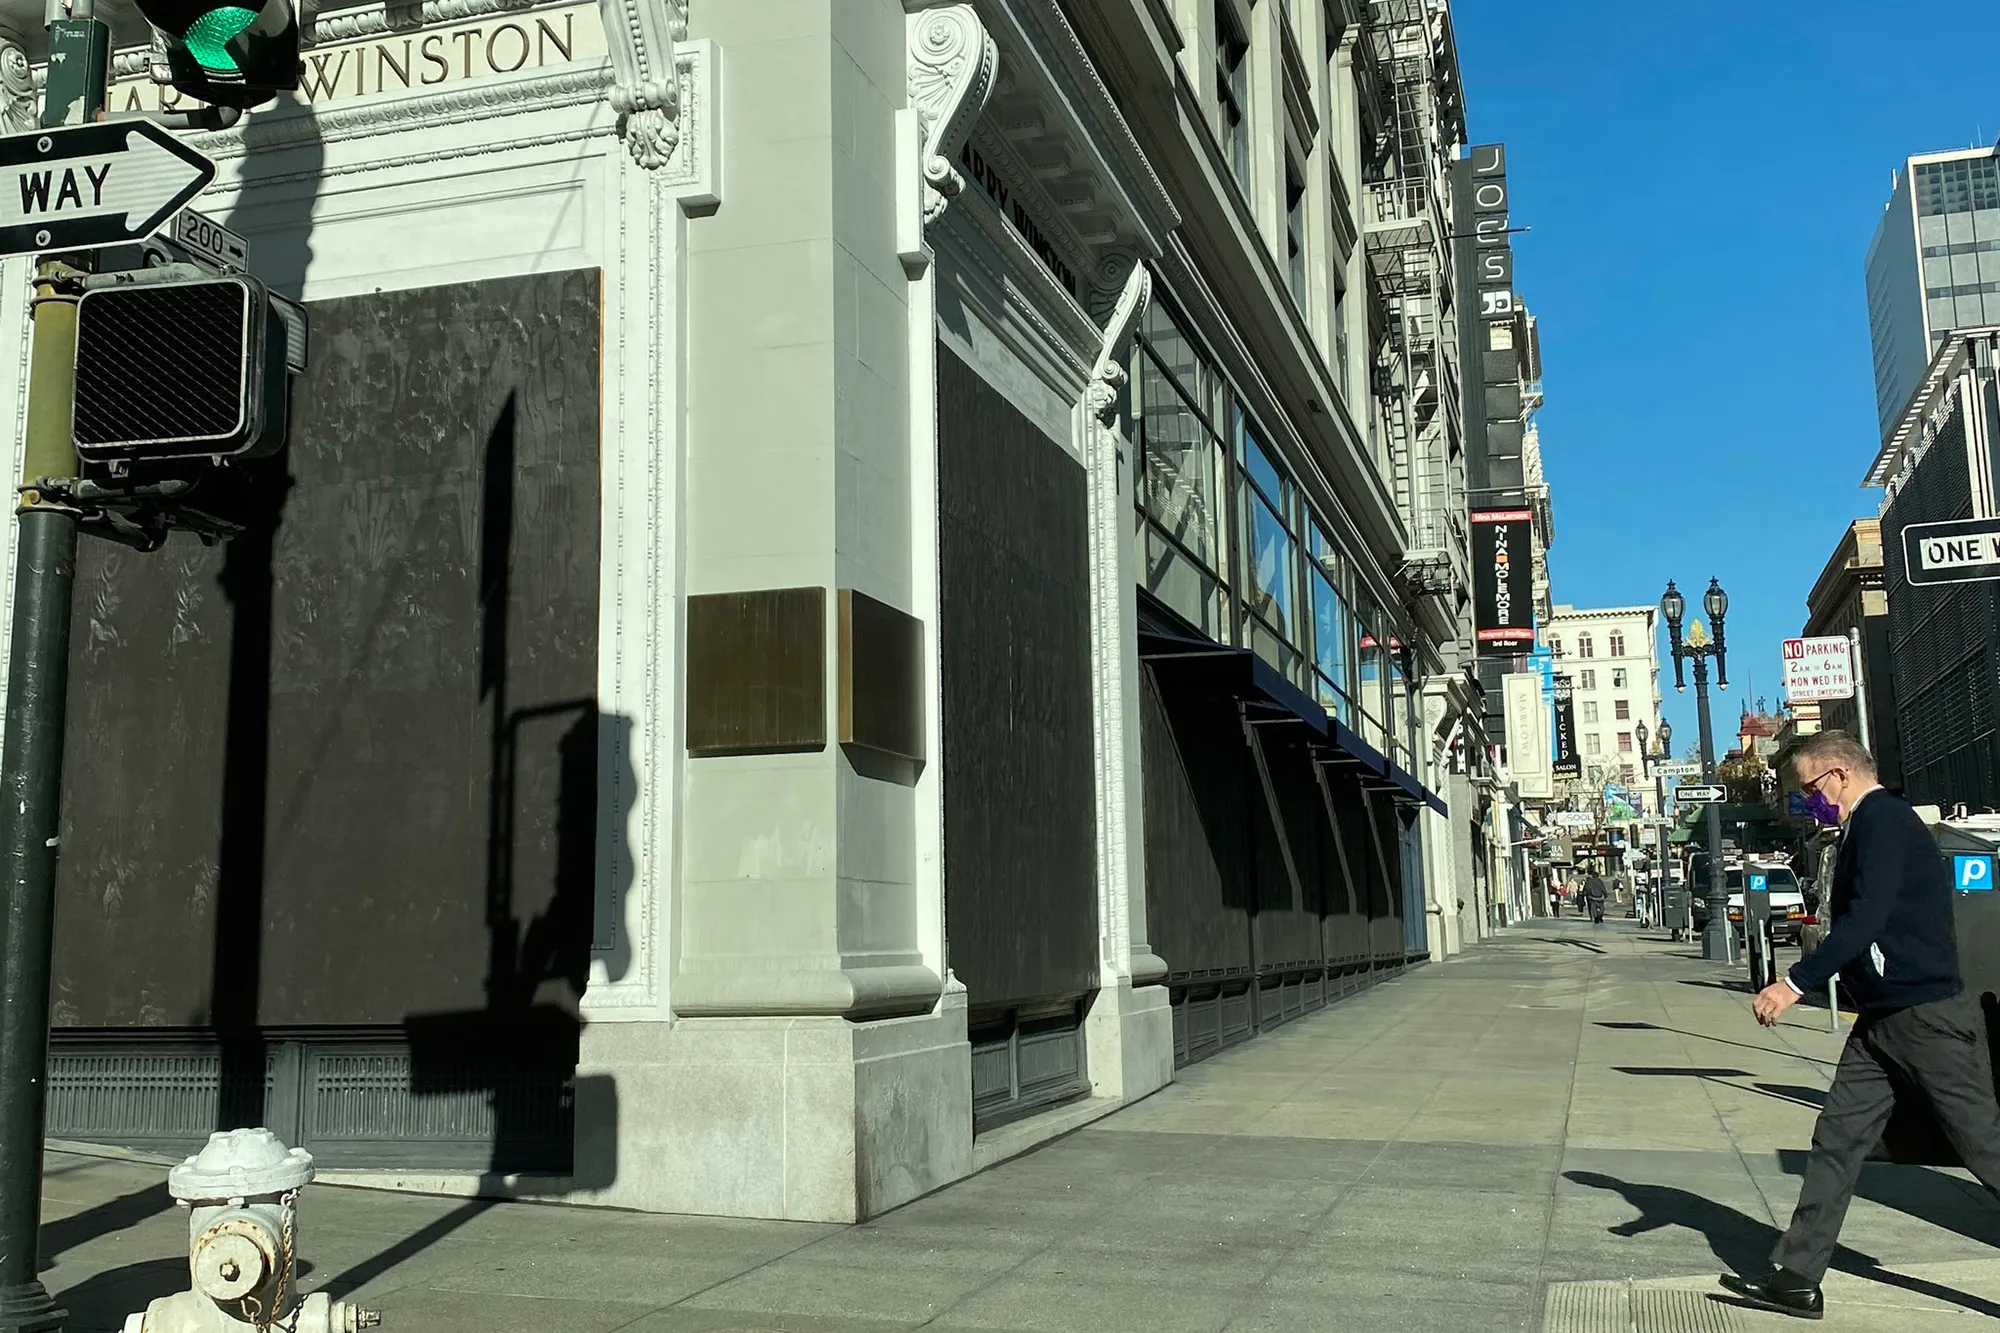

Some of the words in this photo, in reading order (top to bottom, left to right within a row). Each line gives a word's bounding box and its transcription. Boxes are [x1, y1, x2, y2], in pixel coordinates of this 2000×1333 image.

[299, 13, 574, 104] WINSTON
[961, 140, 1009, 211] ARRY
[19, 162, 113, 215] WAY
[185, 215, 224, 255] 200
[1928, 539, 1984, 564] ONE
[1784, 641, 1803, 659] NO
[1806, 642, 1845, 656] PARKING
[1790, 661, 1798, 673] 2
[1823, 659, 1831, 671] 6
[1790, 676, 1809, 687] MON
[1812, 675, 1830, 686] WED
[1833, 674, 1847, 684] FRI
[1792, 690, 1814, 698] STREET
[1556, 704, 1570, 760] WICKED
[1555, 763, 1577, 771] SALON
[1656, 766, 1695, 775] Campton
[1680, 790, 1694, 798] ONE
